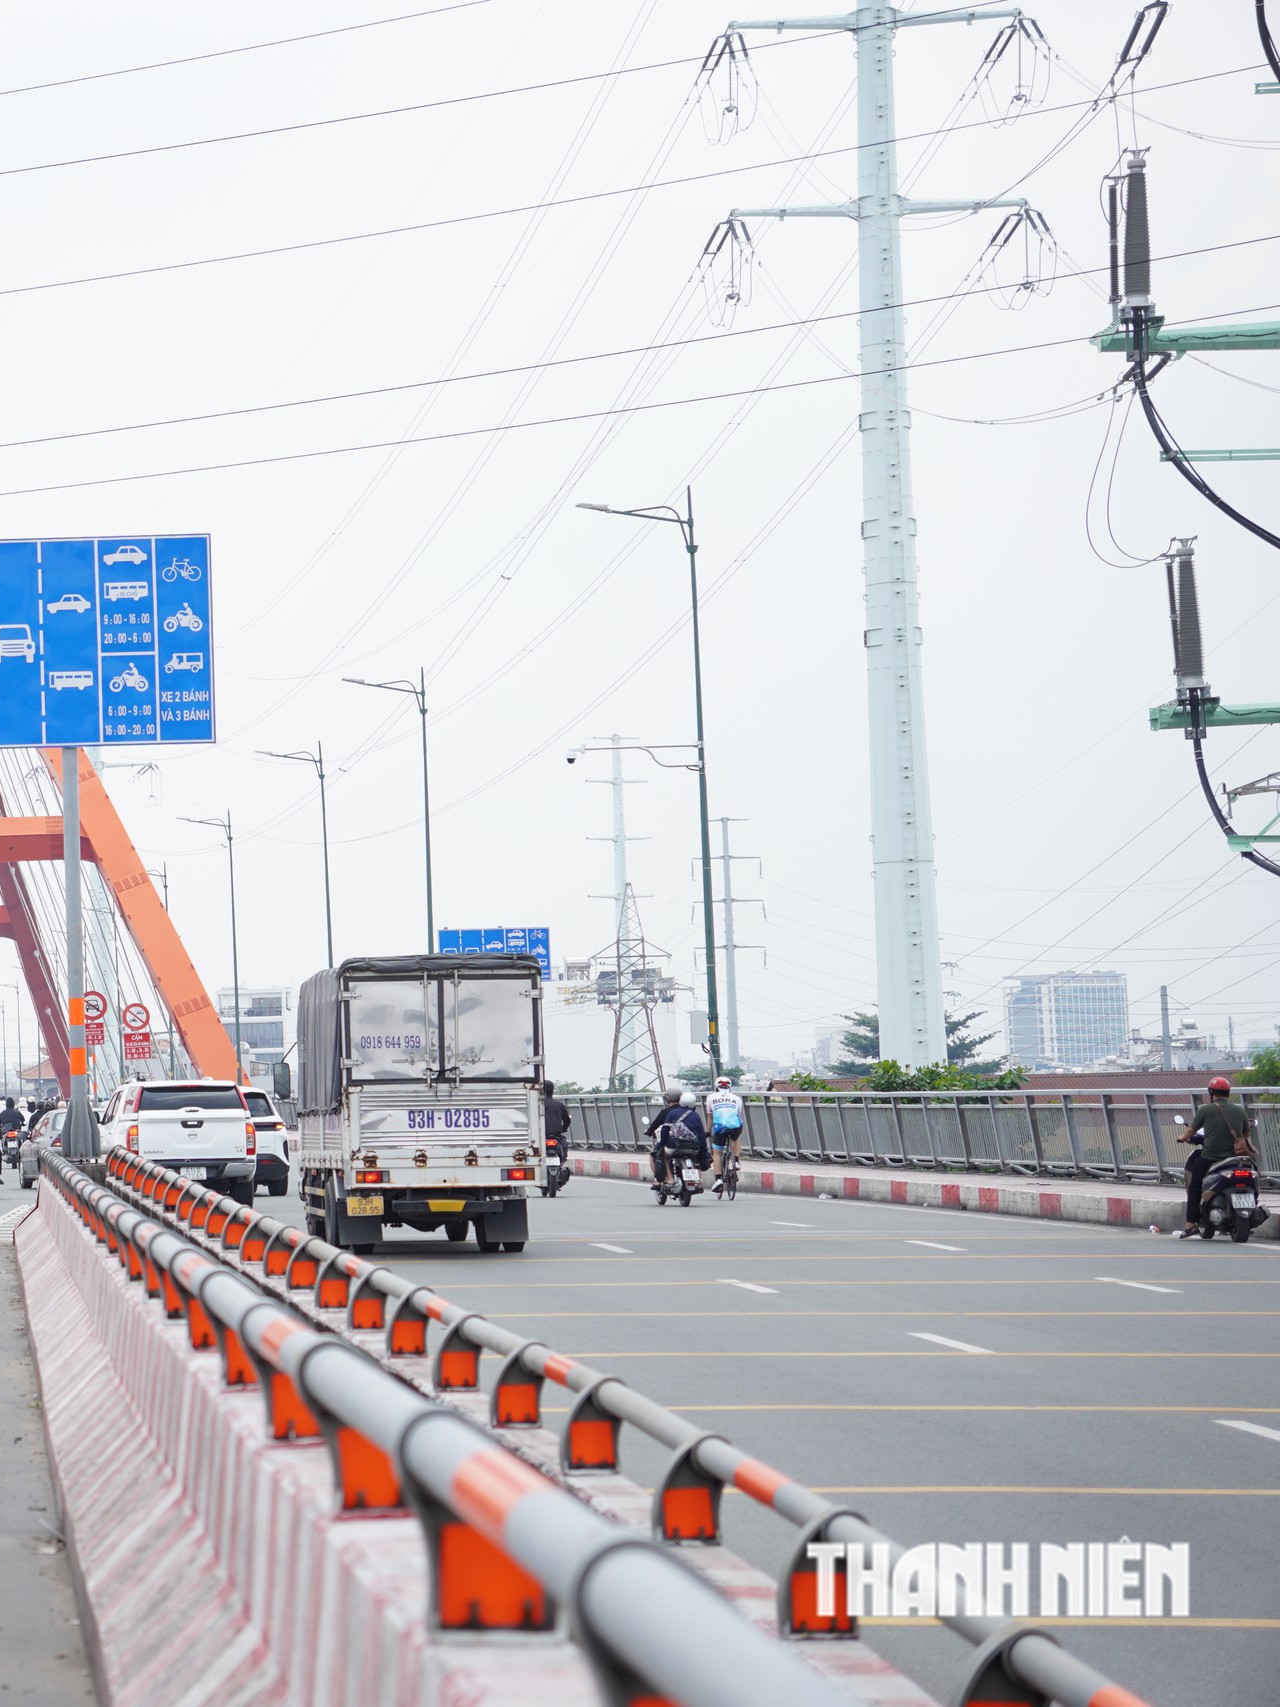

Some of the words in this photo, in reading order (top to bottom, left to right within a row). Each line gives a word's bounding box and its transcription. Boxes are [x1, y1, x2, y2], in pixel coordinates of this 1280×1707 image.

[161, 691, 173, 702] XE
[175, 691, 180, 702] 2
[182, 688, 209, 702] BÁNH
[161, 708, 174, 721] VÀ
[176, 710, 181, 721] 3
[183, 707, 210, 721] BÁNH
[360, 1036, 382, 1049] 0918
[385, 1036, 401, 1048] 644
[404, 1035, 420, 1048] 959
